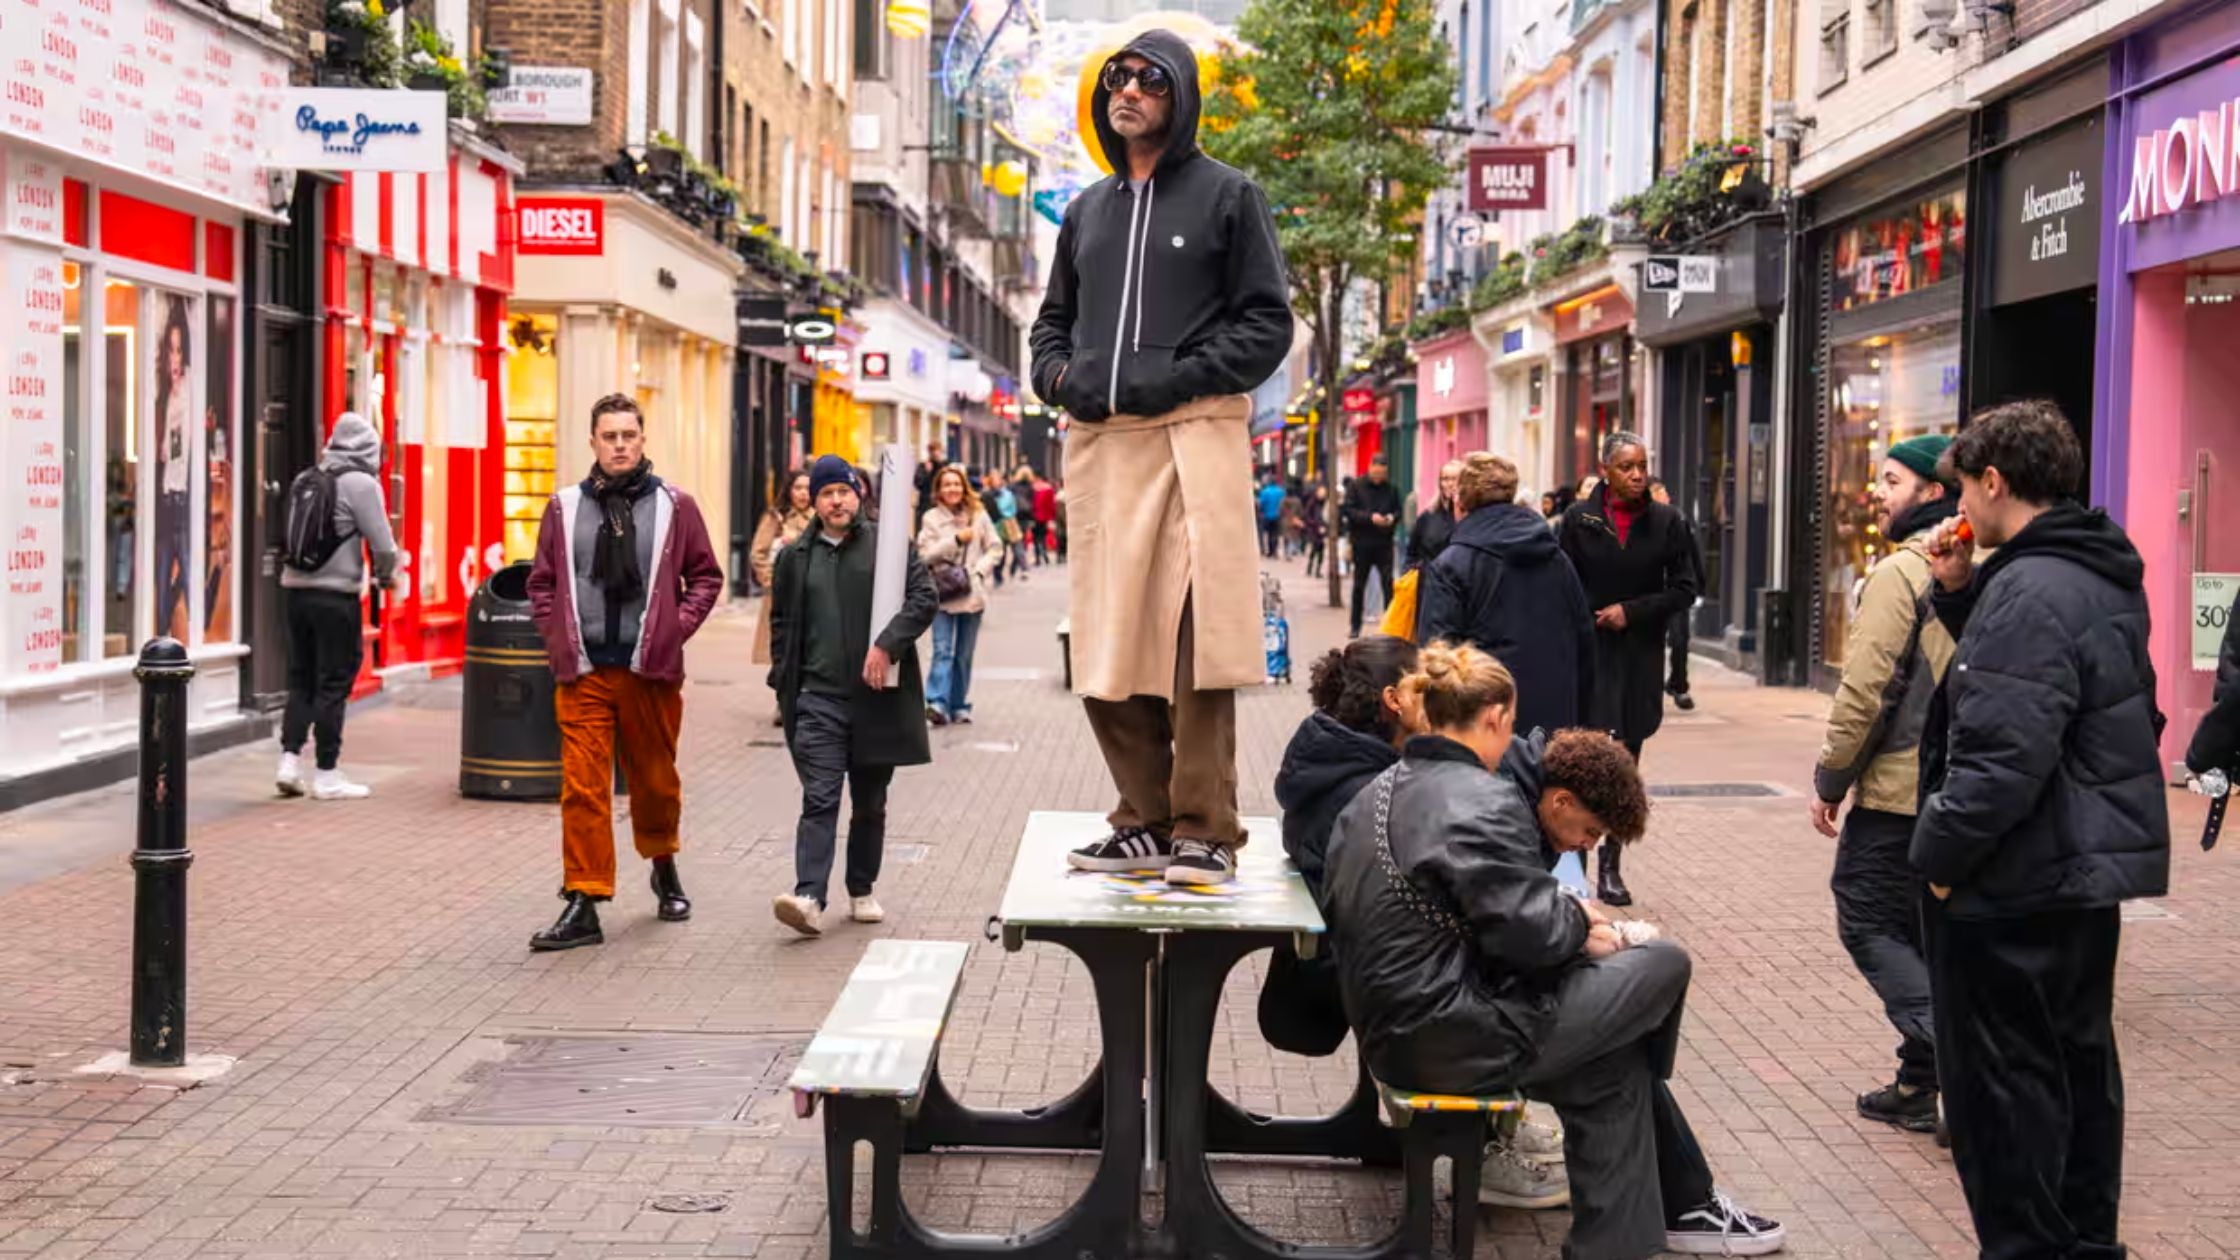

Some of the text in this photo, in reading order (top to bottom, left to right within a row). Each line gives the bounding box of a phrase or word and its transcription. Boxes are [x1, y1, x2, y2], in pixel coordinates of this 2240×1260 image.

[43, 29, 78, 60] LONDON
[514, 73, 582, 88] BOROUGH
[7, 80, 44, 109] LONDON
[80, 104, 113, 132] LONDON
[296, 104, 349, 142] Pepe
[353, 112, 421, 145] Jeans
[1481, 164, 1535, 189] MUJI
[17, 183, 54, 208] LONDON
[2021, 171, 2085, 224] Abercrombie
[522, 207, 597, 238] DIESEL
[2031, 216, 2068, 261] & Fitch
[26, 289, 61, 311] LONDON
[9, 375, 45, 396] LONDON
[27, 466, 61, 485] LONDON
[8, 550, 43, 570] LONDON
[2197, 579, 2225, 590] Up to
[26, 629, 61, 651] LONDON
